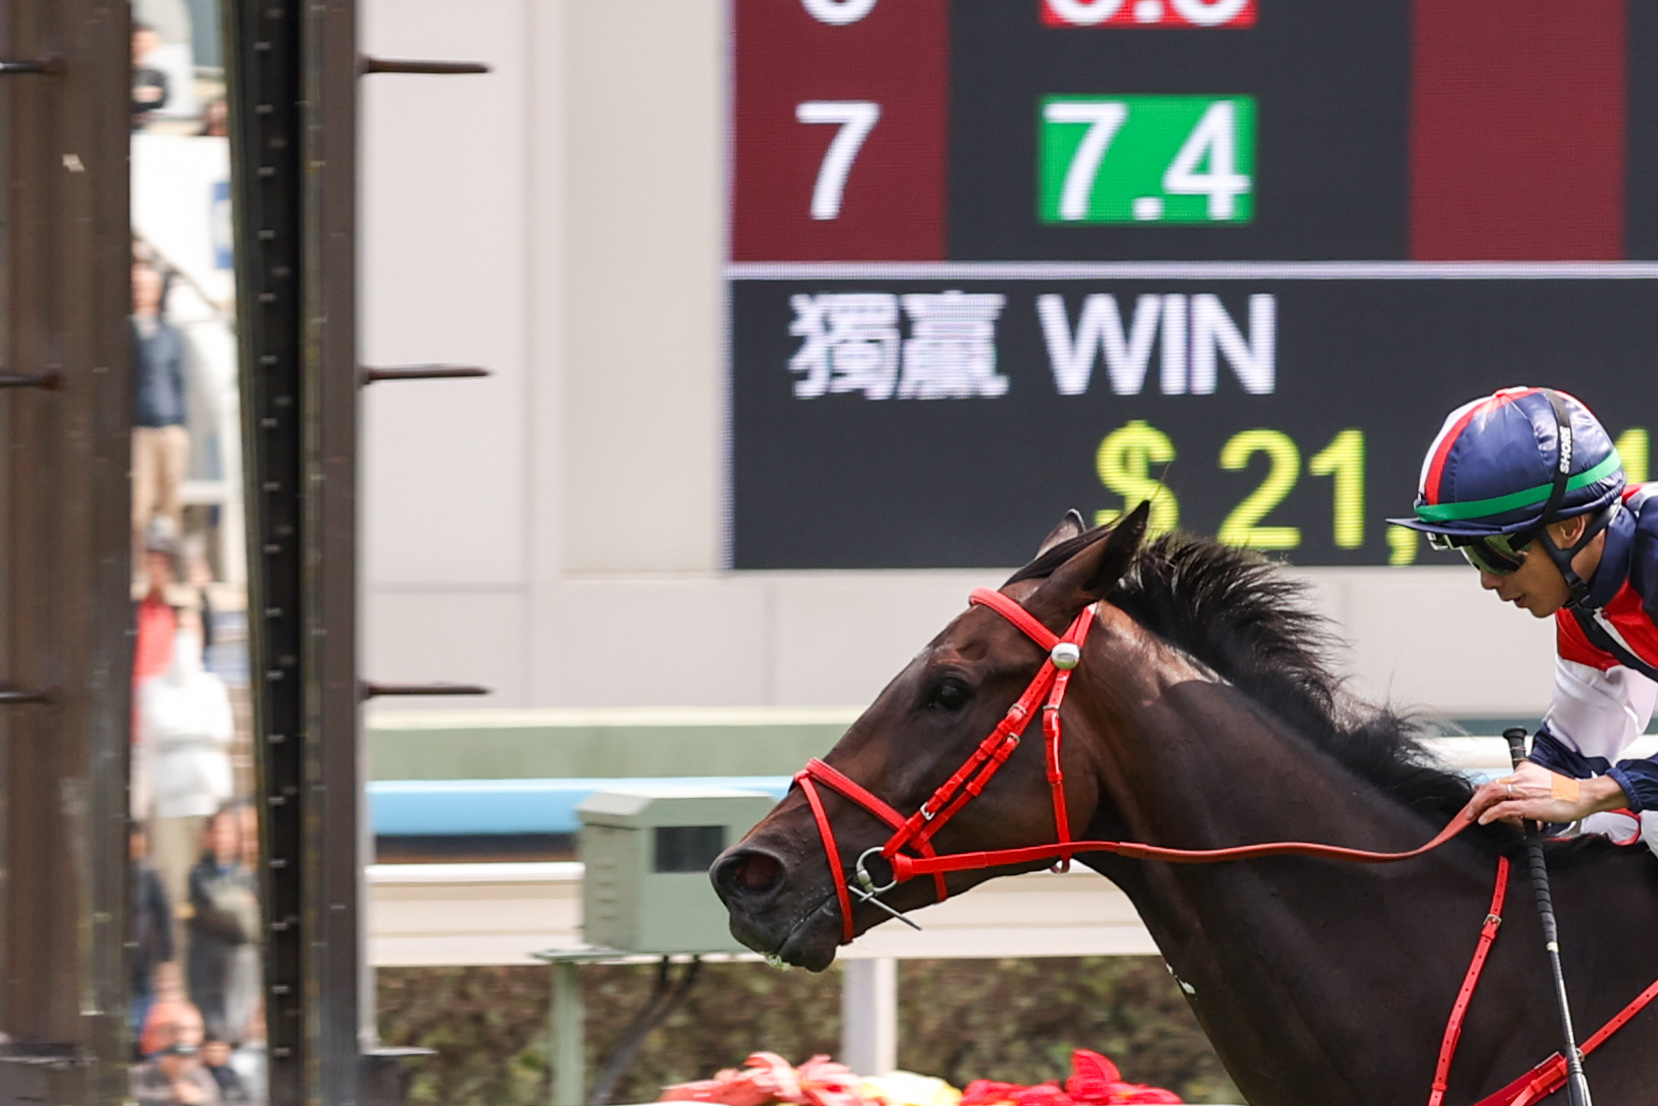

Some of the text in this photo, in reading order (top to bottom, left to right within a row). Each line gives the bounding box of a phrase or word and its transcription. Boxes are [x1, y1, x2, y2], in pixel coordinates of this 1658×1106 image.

[796, 100, 882, 220] 7
[1043, 100, 1252, 221] 7.4
[788, 290, 1276, 399] 獨贏 WIN
[1559, 425, 1572, 475] SHORE
